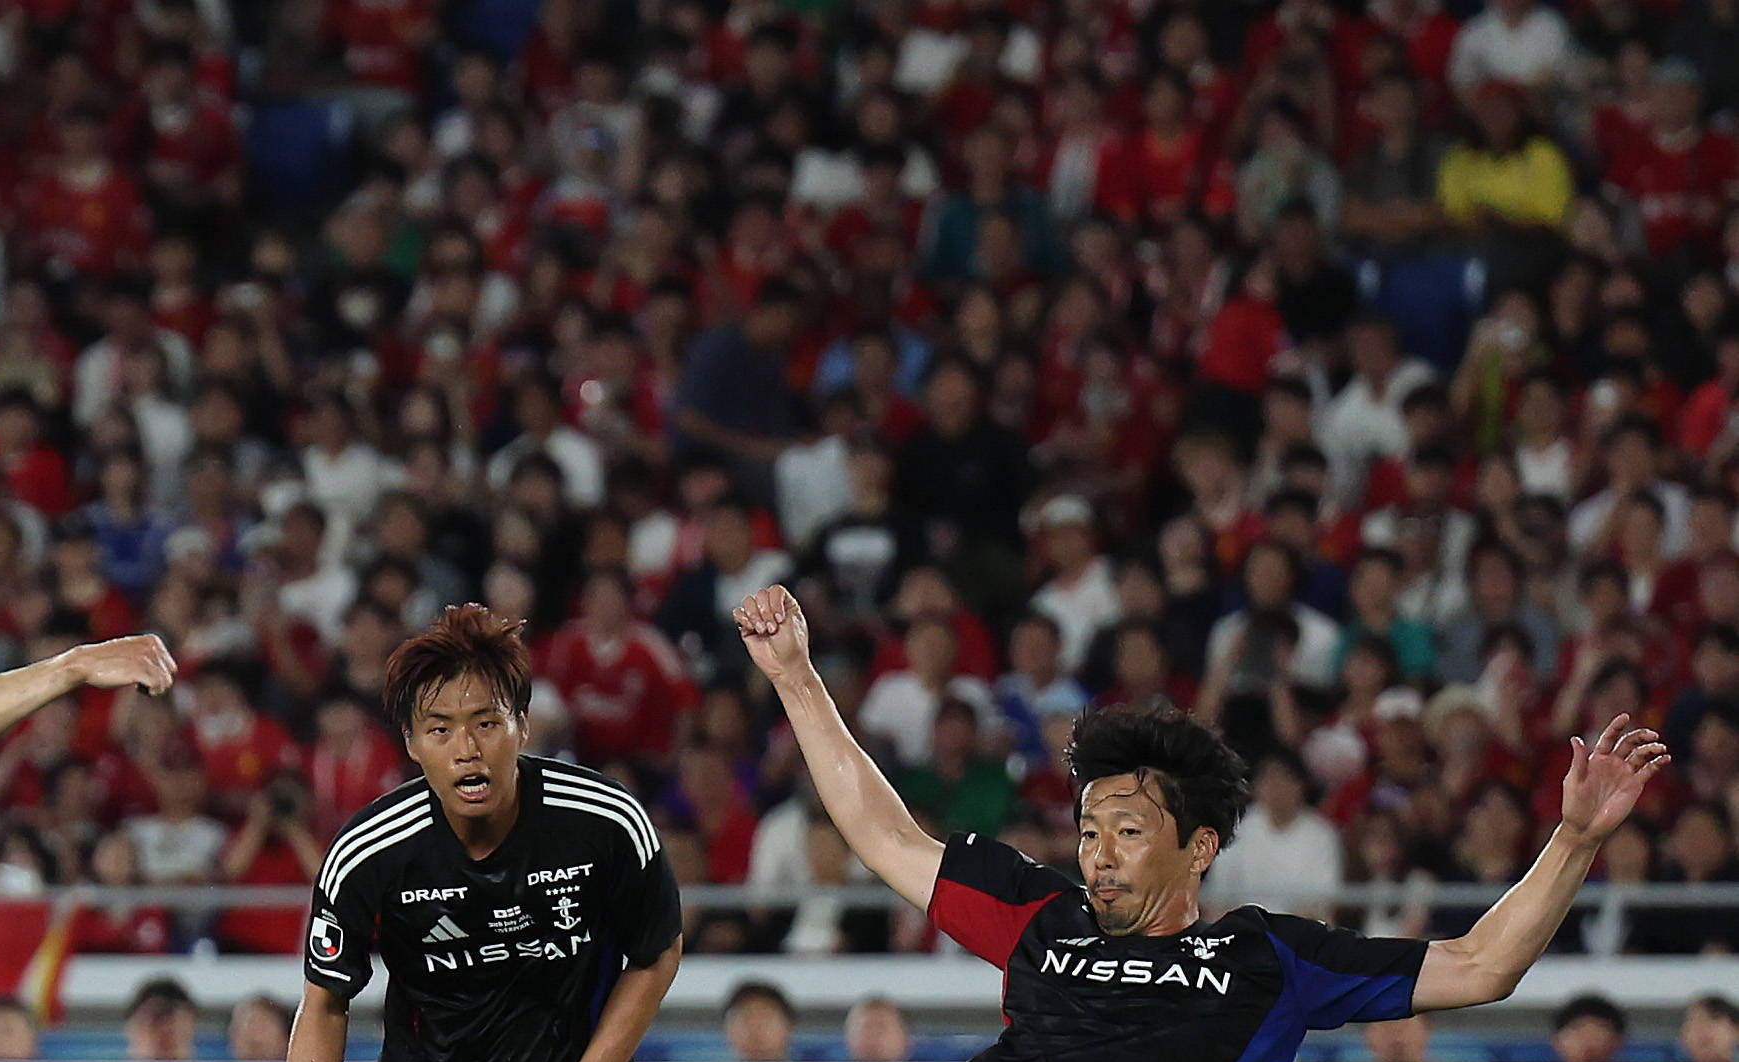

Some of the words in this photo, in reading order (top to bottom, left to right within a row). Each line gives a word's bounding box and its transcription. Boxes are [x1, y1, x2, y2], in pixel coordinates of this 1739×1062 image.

[527, 863, 593, 886] DRAFT
[401, 887, 468, 904] DRAFT
[424, 928, 592, 972] NISSAN
[1040, 949, 1231, 995] NISSAN
